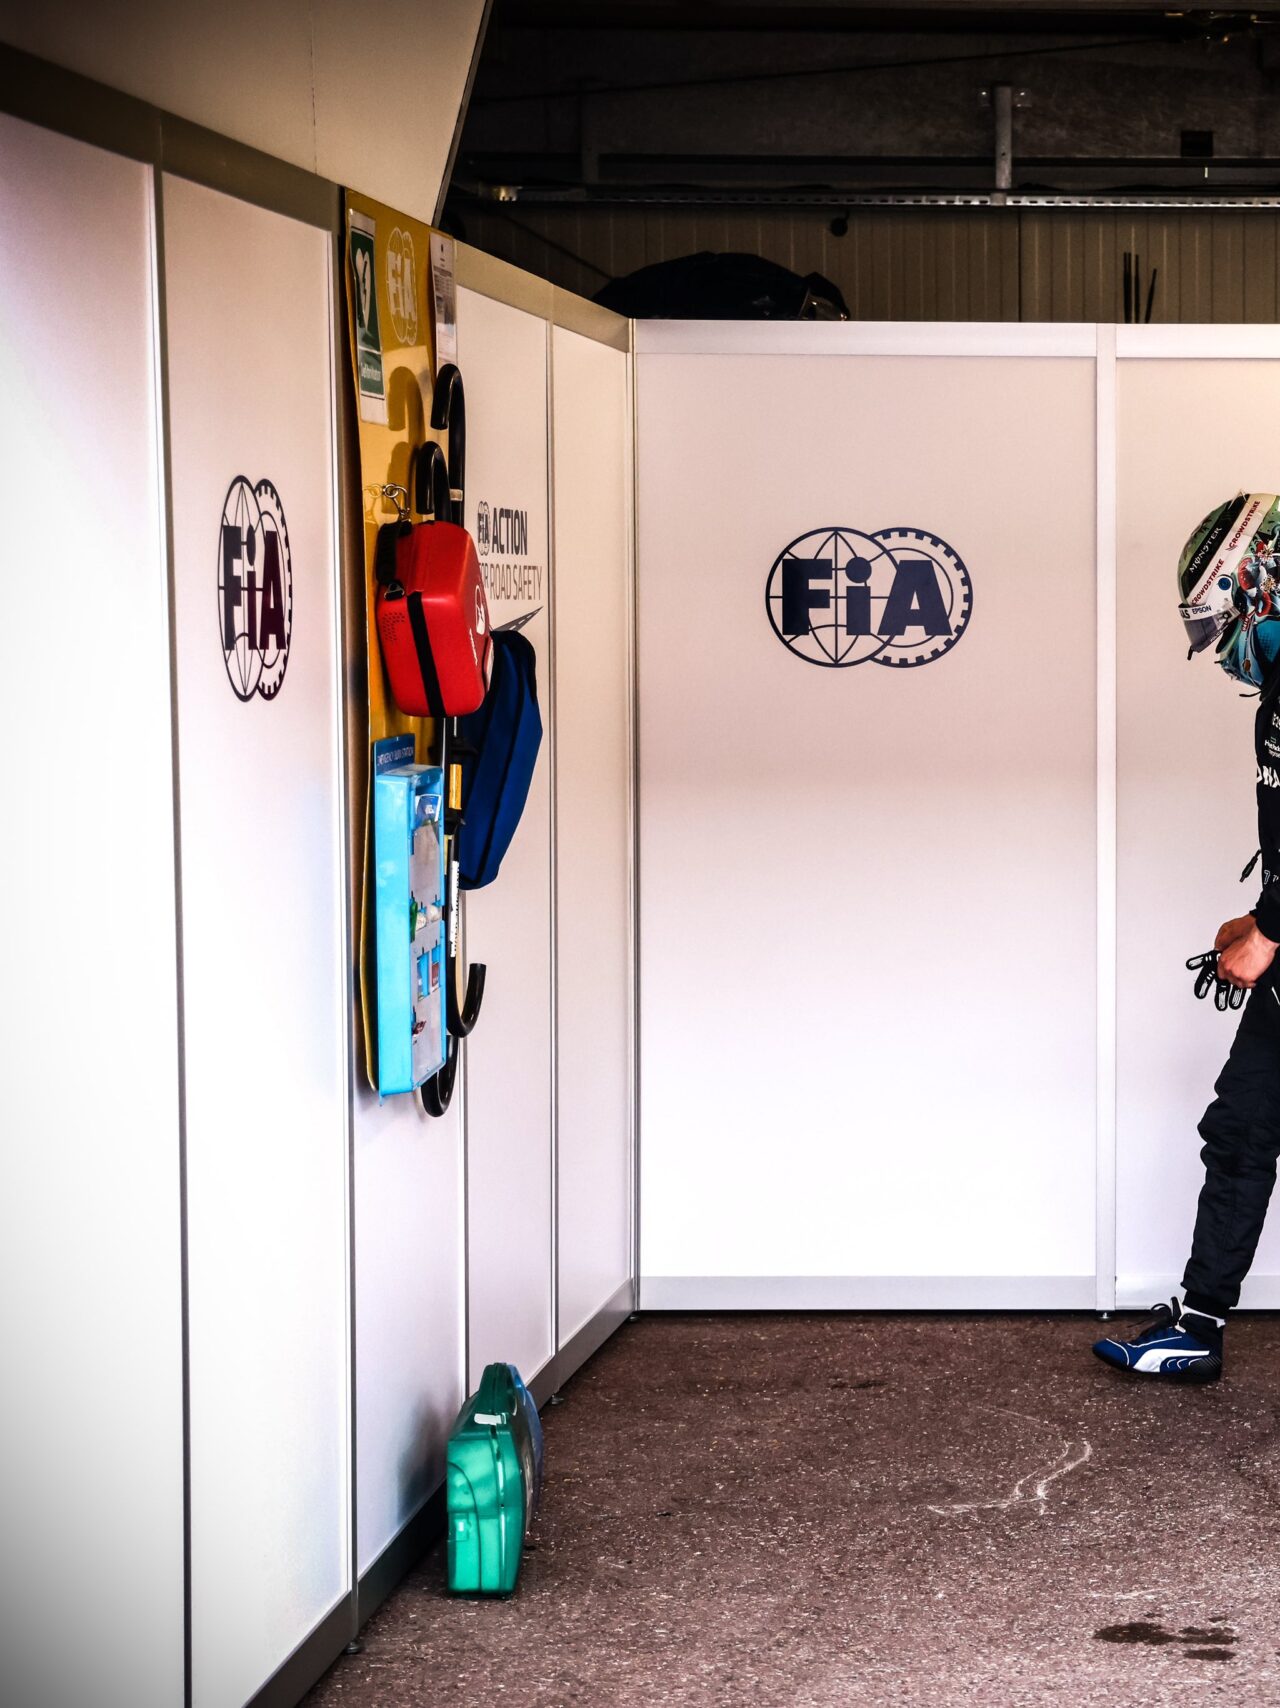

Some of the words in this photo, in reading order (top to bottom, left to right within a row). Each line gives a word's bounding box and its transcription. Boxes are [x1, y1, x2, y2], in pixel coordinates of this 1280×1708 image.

[491, 507, 528, 556] ACTION
[1228, 500, 1261, 549] CROWDSTRIKE
[490, 563, 512, 600] ROAD
[513, 564, 543, 601] SAFETY
[1191, 558, 1225, 607] CROWDSTRIKE
[1192, 605, 1212, 615] EPSON
